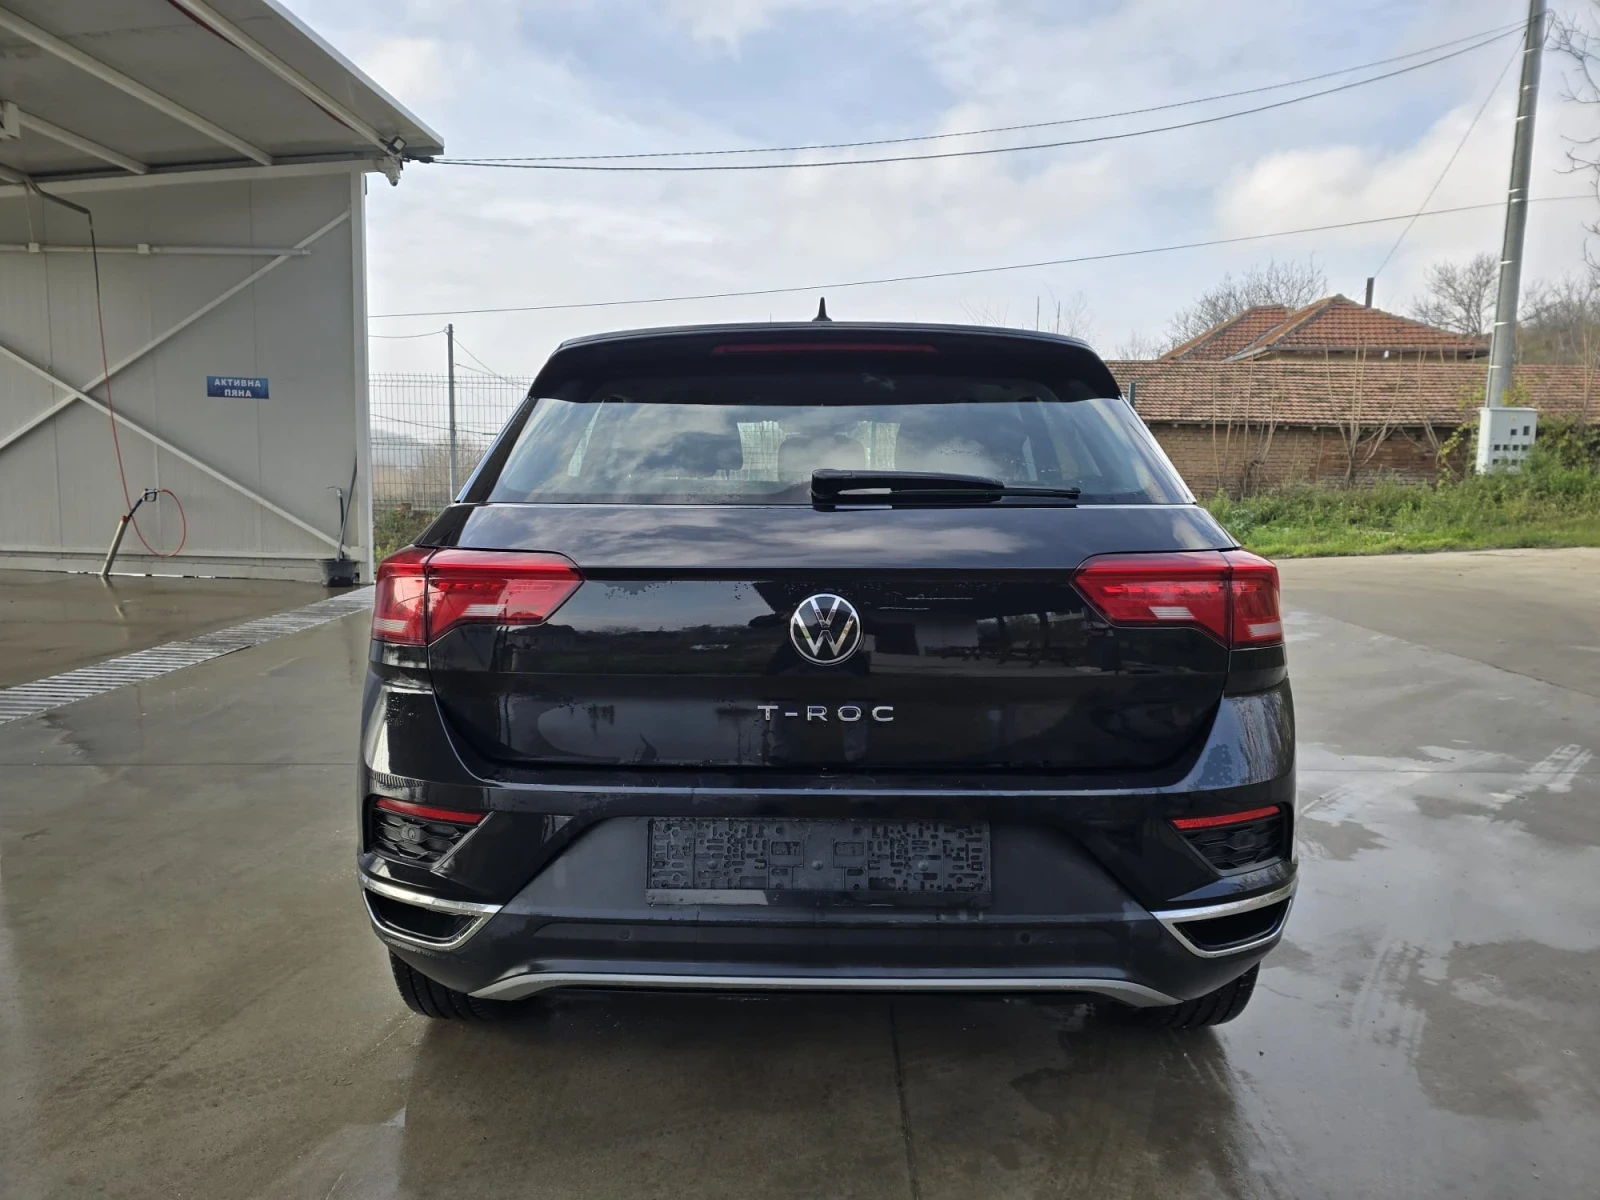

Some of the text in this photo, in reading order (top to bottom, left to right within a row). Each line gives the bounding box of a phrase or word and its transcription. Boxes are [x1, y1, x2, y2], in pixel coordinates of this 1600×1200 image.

[214, 378, 261, 388] АКТИВНА
[224, 388, 252, 397] ПЯНА
[791, 594, 861, 663] VW
[757, 705, 894, 722] T-ROC
